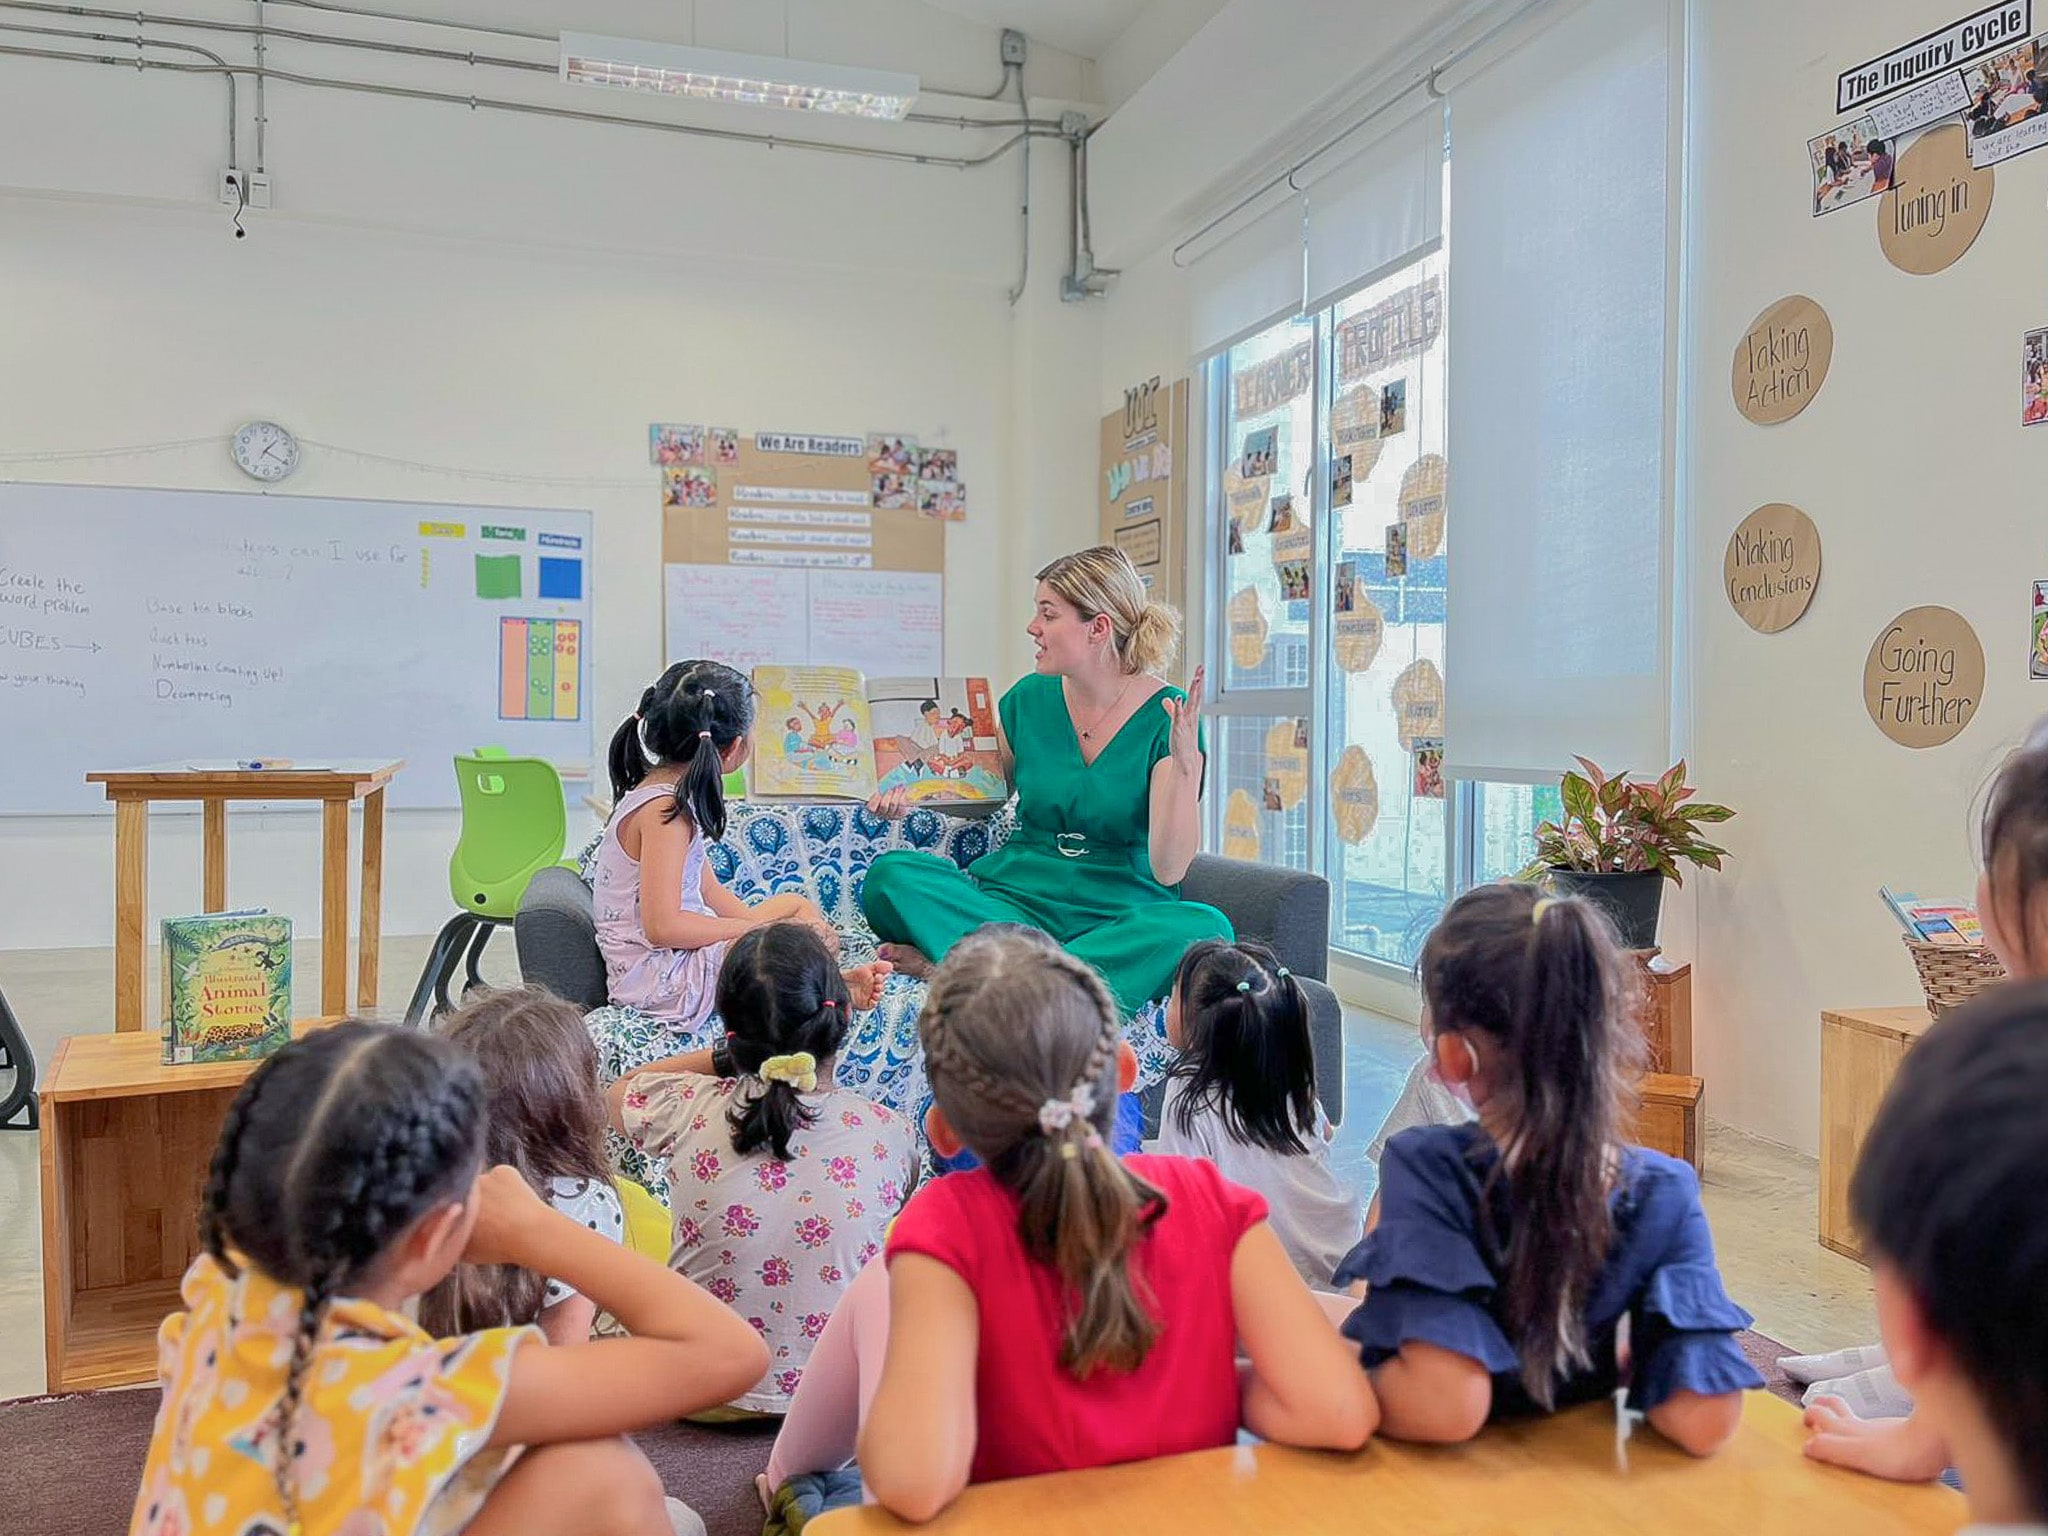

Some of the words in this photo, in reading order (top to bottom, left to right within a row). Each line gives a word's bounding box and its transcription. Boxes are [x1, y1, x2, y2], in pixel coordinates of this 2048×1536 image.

[1847, 71, 1879, 100] The
[1884, 39, 1955, 85] Inquiry
[1962, 9, 2021, 52] Cycle
[1889, 181, 1947, 238] Tuning
[1951, 178, 1969, 214] in
[1746, 326, 1811, 376] Taking
[1746, 367, 1811, 410] Action
[760, 435, 781, 448] We
[784, 437, 805, 450] Are
[808, 438, 860, 454] Readers
[1734, 531, 1796, 574] Making
[43, 597, 90, 616] problem
[57, 577, 87, 594] the
[1730, 573, 1812, 604] Conclusions
[1879, 627, 1956, 687] Going
[1878, 681, 1973, 725] Further
[202, 982, 266, 1001] Animal
[203, 1003, 263, 1018] Stories
